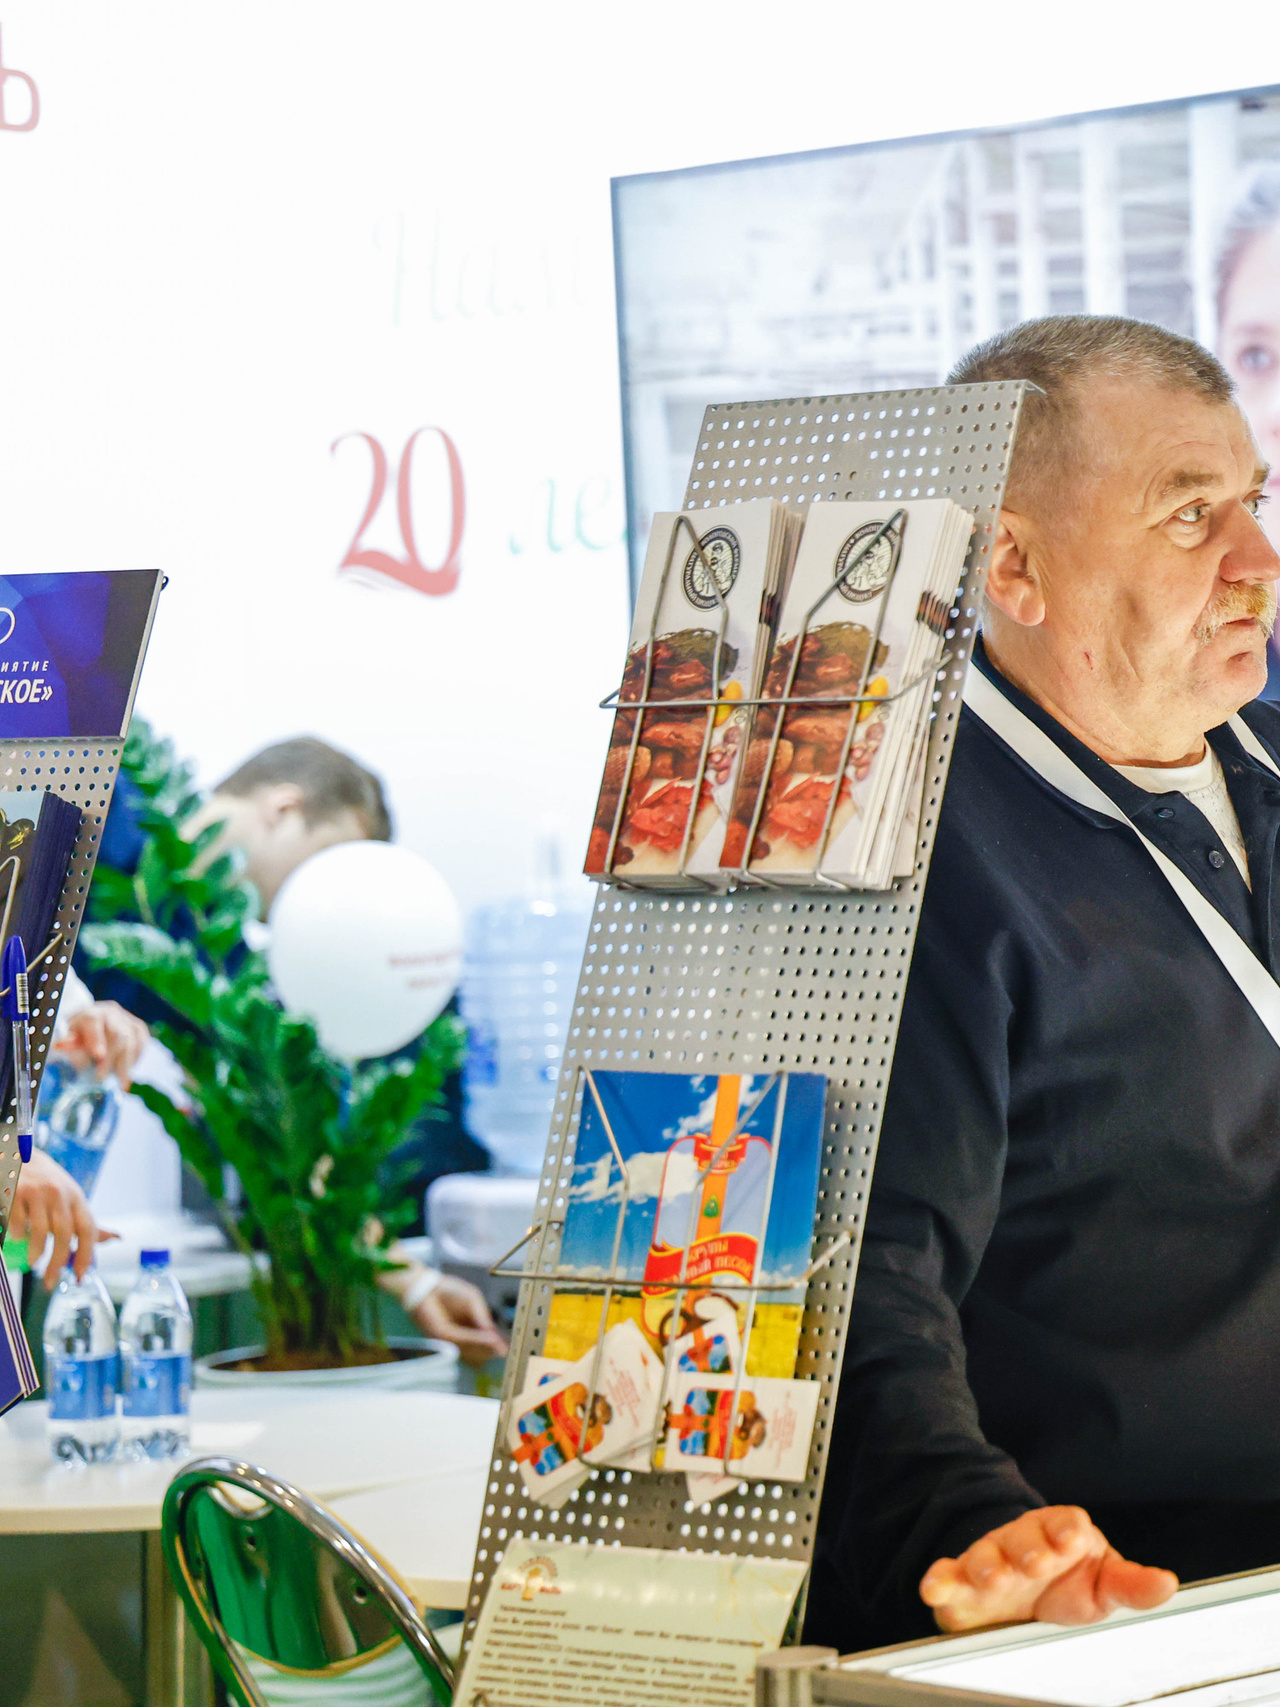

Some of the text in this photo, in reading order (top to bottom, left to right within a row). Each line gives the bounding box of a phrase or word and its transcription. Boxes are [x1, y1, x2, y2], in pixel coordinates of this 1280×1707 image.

[327, 423, 625, 601] 20 ле
[0, 660, 50, 673] ИЯТИЕ
[0, 678, 54, 704] КОЕ»
